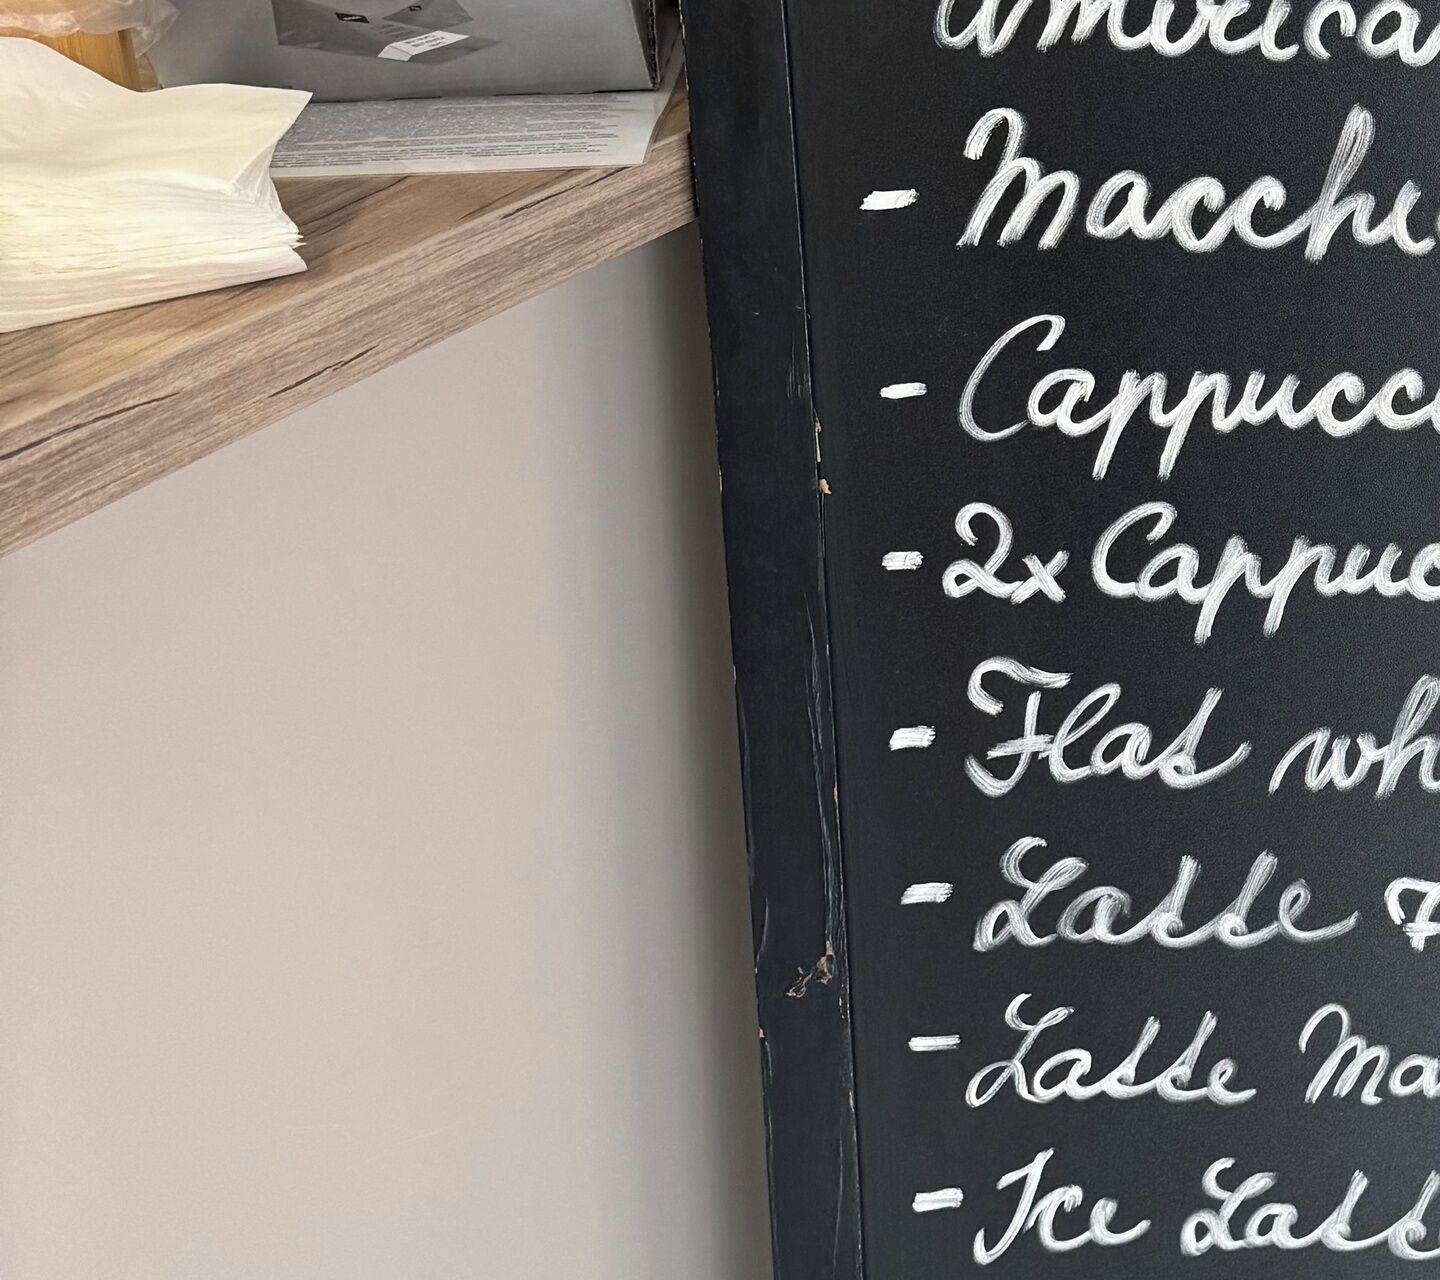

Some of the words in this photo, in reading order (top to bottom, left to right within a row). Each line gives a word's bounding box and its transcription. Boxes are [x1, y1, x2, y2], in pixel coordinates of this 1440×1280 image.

[942, 502, 1069, 604] 2x
[966, 656, 1251, 797] Flat
[973, 836, 1358, 952] Latte
[965, 994, 1256, 1107] Latte
[973, 1149, 1151, 1265] Ice
